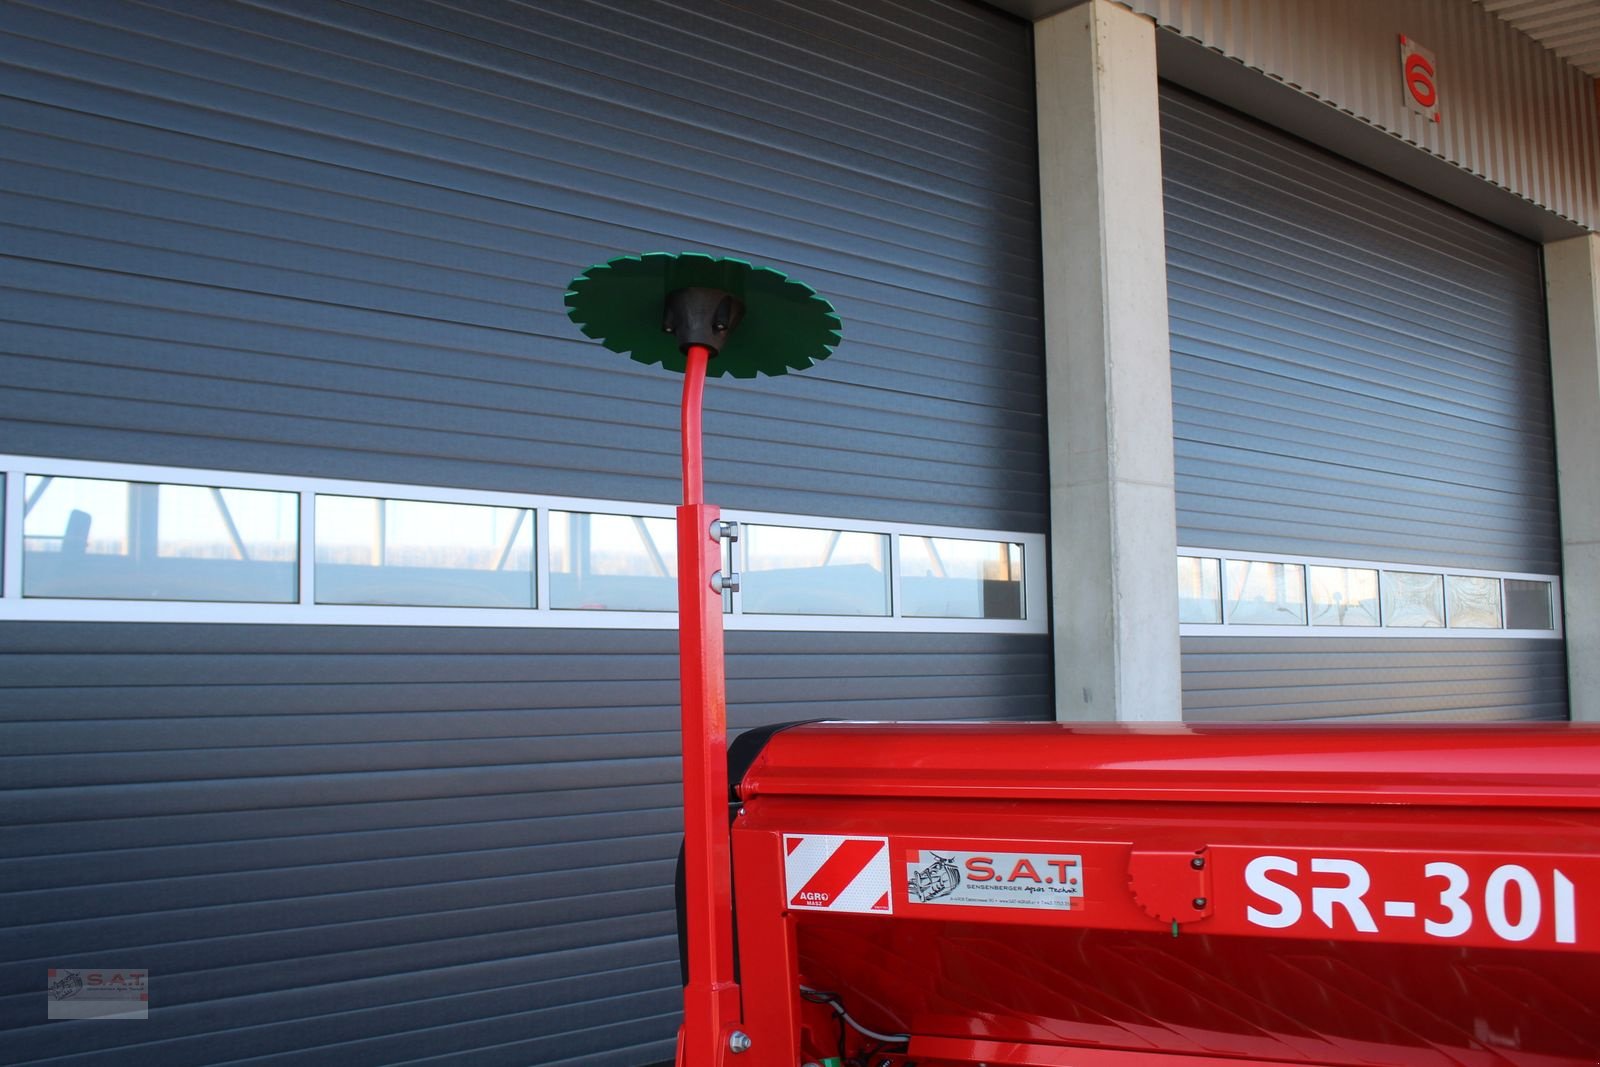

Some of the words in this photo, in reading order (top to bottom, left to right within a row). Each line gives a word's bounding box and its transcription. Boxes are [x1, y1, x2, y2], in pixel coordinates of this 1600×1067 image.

[1405, 54, 1436, 108] 6
[965, 857, 1079, 885] S.A.T.
[800, 892, 829, 901] AGRO
[966, 884, 1023, 892] SENSENBERGER
